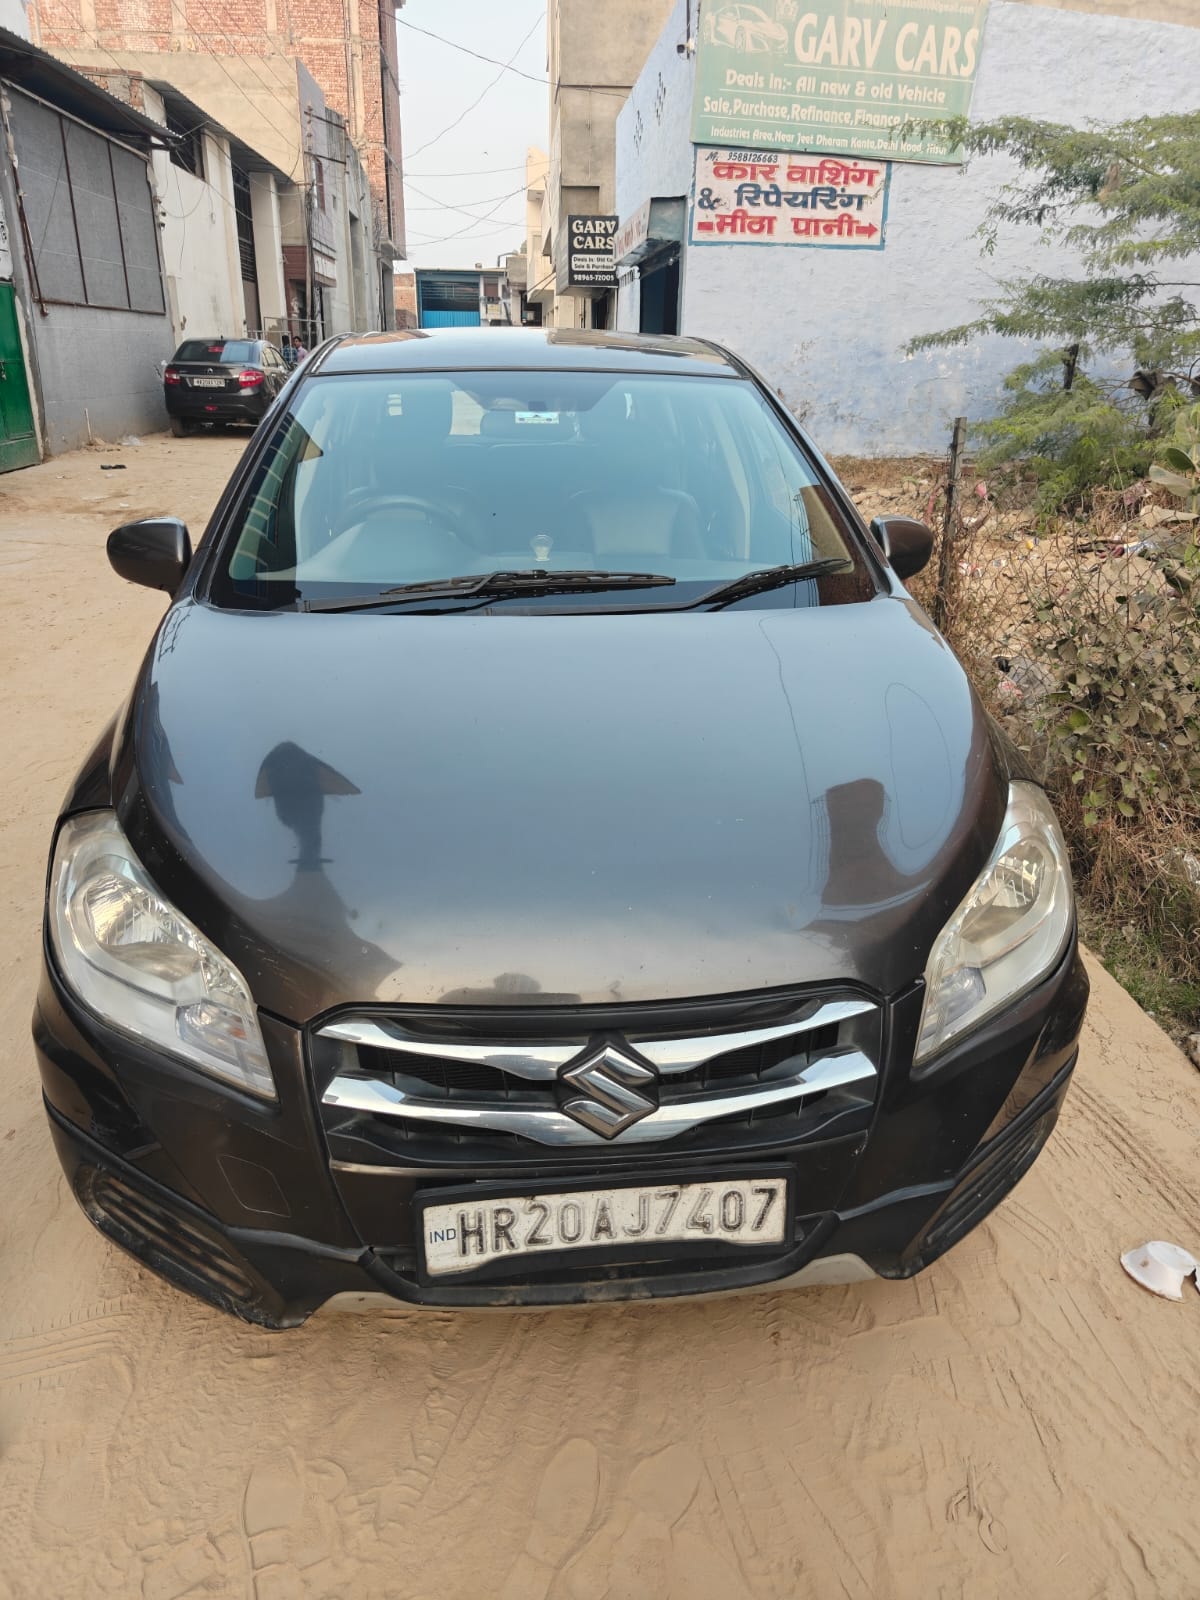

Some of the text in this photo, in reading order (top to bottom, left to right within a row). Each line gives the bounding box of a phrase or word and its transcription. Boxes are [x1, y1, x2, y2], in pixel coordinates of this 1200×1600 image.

[794, 12, 980, 77] GARV CARS
[726, 69, 765, 88] Deals
[796, 77, 816, 93] All
[820, 81, 850, 96] new
[855, 81, 866, 97] &
[870, 82, 893, 99] old
[898, 84, 946, 103] Vehicle
[711, 126, 750, 139] Industries
[816, 135, 849, 148] Dharam
[727, 152, 778, 163] 9588126663
[713, 159, 880, 187] कार वाशिंग
[698, 183, 869, 211] & रिपेयरिंग
[572, 219, 617, 234] GARV
[715, 209, 860, 238] मीठा पानी
[573, 235, 614, 249] CARS
[429, 1186, 778, 1259] IND HR20AJ7407
